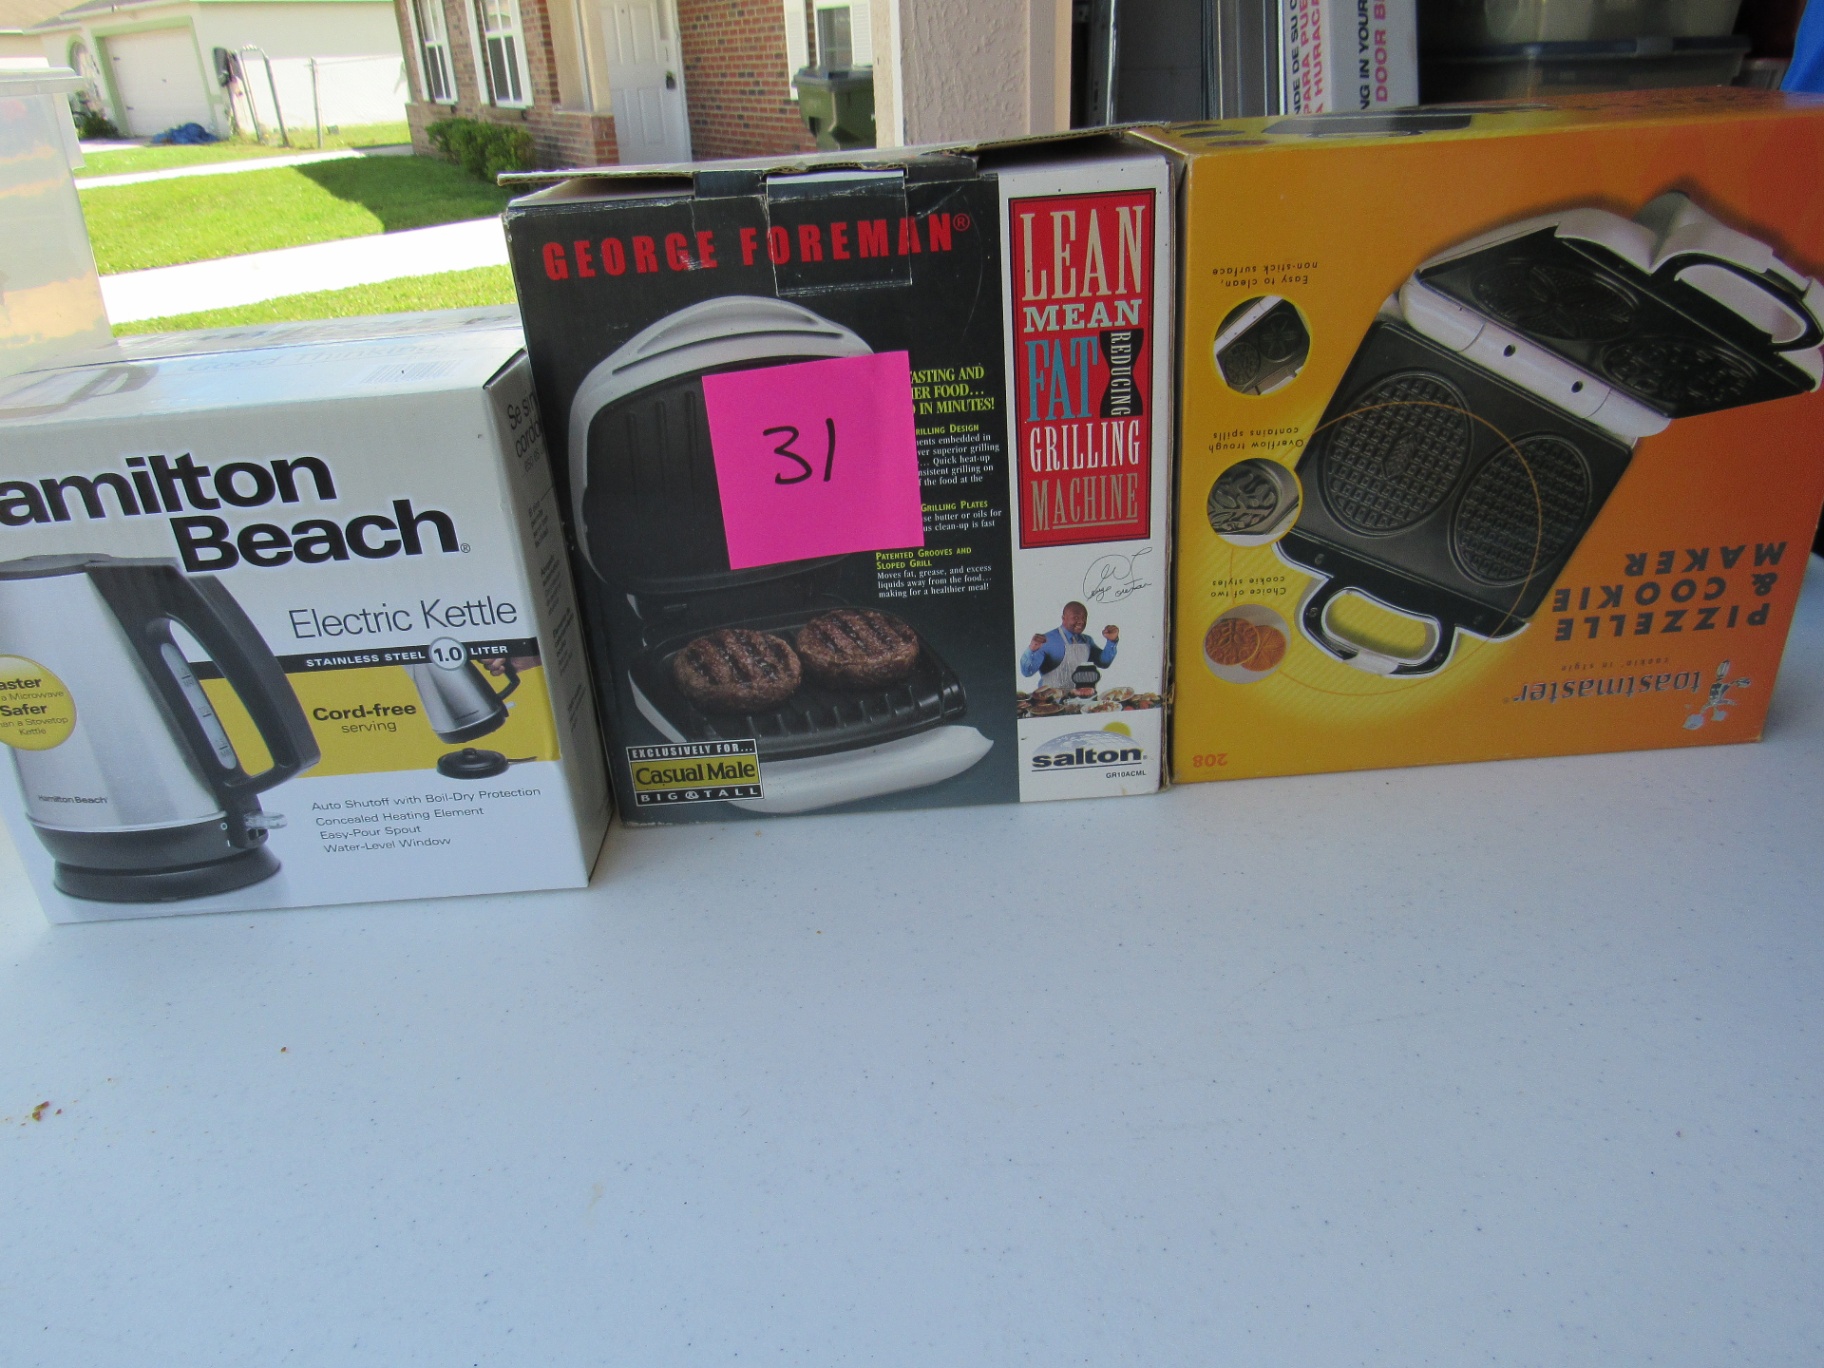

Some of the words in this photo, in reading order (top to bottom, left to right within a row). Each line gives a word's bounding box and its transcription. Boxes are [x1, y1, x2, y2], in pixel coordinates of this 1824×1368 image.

[1290, 15, 1298, 43] SU
[1358, 0, 1369, 55] YOUR
[1291, 47, 1299, 74] DE
[1359, 59, 1370, 79] IN
[1374, 29, 1388, 102] DOOR
[542, 230, 718, 281] GEORGE
[1020, 205, 1146, 301] LEAN
[1212, 265, 1257, 277] surface
[1263, 262, 1318, 277] non-stick
[1263, 277, 1275, 286] to
[1281, 274, 1309, 285] Easy
[1023, 299, 1142, 333] MEAN
[910, 367, 956, 384] ASTING
[958, 365, 985, 382] AND
[1025, 336, 1099, 423] FAT
[1110, 331, 1132, 416] REDUCING
[920, 402, 933, 415] IN
[936, 397, 995, 414] MINUTES!
[507, 404, 523, 430] Se
[938, 434, 980, 445] embedded
[982, 433, 991, 442] in
[1212, 428, 1244, 441] spills
[1249, 427, 1299, 438] contains
[763, 418, 836, 485] 31
[932, 446, 967, 458] superior
[970, 443, 1000, 455] grilling
[1029, 420, 1140, 473] GRILLING
[1208, 441, 1245, 454] trough
[1250, 438, 1304, 450] Overflow
[933, 456, 957, 467] Quick
[959, 454, 991, 465] heat-up
[951, 465, 981, 477] grilling
[983, 464, 994, 472] on
[0, 452, 337, 526] amilton
[924, 476, 937, 487] the
[939, 475, 958, 486] food
[960, 476, 968, 484] at
[970, 474, 984, 483] the
[1031, 473, 1139, 532] MACHINE
[934, 512, 959, 522] butter
[973, 510, 988, 519] oils
[990, 509, 1002, 517] for
[934, 523, 969, 533] clean-up
[971, 521, 979, 529] is
[981, 520, 995, 528] fast
[1625, 542, 1787, 577] MAKER
[877, 571, 902, 580] Moves
[903, 569, 917, 579] fat,
[919, 568, 947, 579] grease,
[949, 566, 964, 575] and
[966, 565, 992, 573] excess
[1248, 576, 1285, 585] cookie
[878, 580, 905, 591] liquids
[907, 580, 926, 589] away
[928, 578, 949, 586] from
[949, 576, 962, 584] the
[1212, 577, 1243, 588] styles
[1751, 572, 1778, 597] &
[878, 589, 908, 600] making
[909, 588, 922, 597] for
[931, 585, 966, 595] healthier
[968, 583, 990, 592] meal!
[1234, 589, 1245, 599] of
[1249, 587, 1287, 596] Choice
[1552, 576, 1727, 613] COOKIE
[289, 603, 413, 639] Electric
[420, 595, 518, 629] Kettle
[1554, 602, 1771, 642] PIZZELLE
[306, 652, 380, 668] STAINLESS
[384, 650, 426, 662] STEEL
[433, 646, 463, 663] 1.0
[470, 645, 509, 656] LITER
[8, 691, 64, 701] Microwave
[1513, 671, 1701, 704] toastmaster
[0, 704, 48, 717] Safer
[312, 703, 417, 722] Cord-free
[26, 716, 69, 727] Stovetop
[341, 720, 398, 735] serving
[19, 728, 46, 736] Kettle
[632, 745, 712, 759] EXCLUSIVELY
[716, 743, 753, 754] FOR...
[1032, 747, 1143, 768] salton
[1192, 752, 1228, 769] 208
[635, 764, 705, 786] Casual
[706, 761, 756, 781] Male
[1105, 770, 1147, 779] GR10ACML
[38, 794, 75, 804] Hamilton
[75, 795, 108, 805] Beach
[311, 801, 343, 812] Auto
[345, 797, 390, 810] Shutoff
[393, 795, 422, 807] with
[425, 791, 476, 805] Boil-Dry
[478, 786, 542, 800] Protection
[640, 792, 679, 803] BIG
[703, 787, 758, 798] TALL
[315, 813, 379, 827] Concealed
[382, 810, 431, 823] Heating
[434, 806, 485, 819] Element
[320, 827, 381, 841] Easy-Pour
[384, 824, 422, 838] Spout
[323, 840, 396, 854] Water-Level
[399, 836, 452, 849] Window
